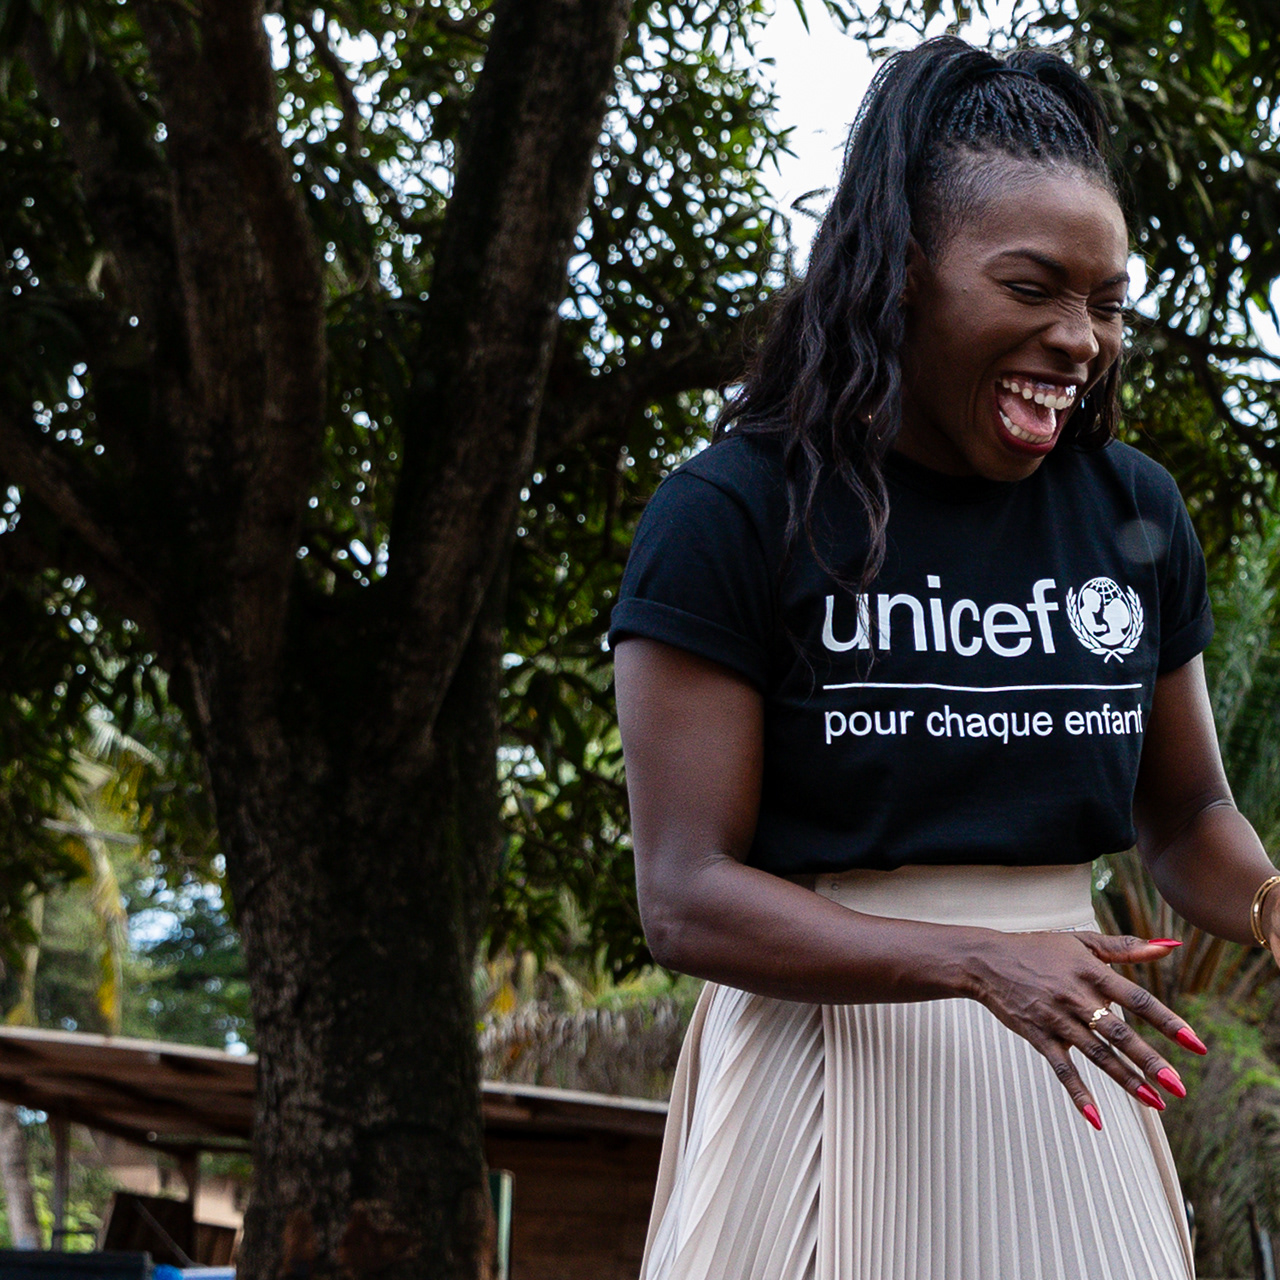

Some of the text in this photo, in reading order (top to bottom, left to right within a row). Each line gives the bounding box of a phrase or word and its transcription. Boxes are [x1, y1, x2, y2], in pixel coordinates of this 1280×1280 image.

[821, 574, 1059, 657] unicef
[824, 702, 1144, 745] pour chaque enfant
